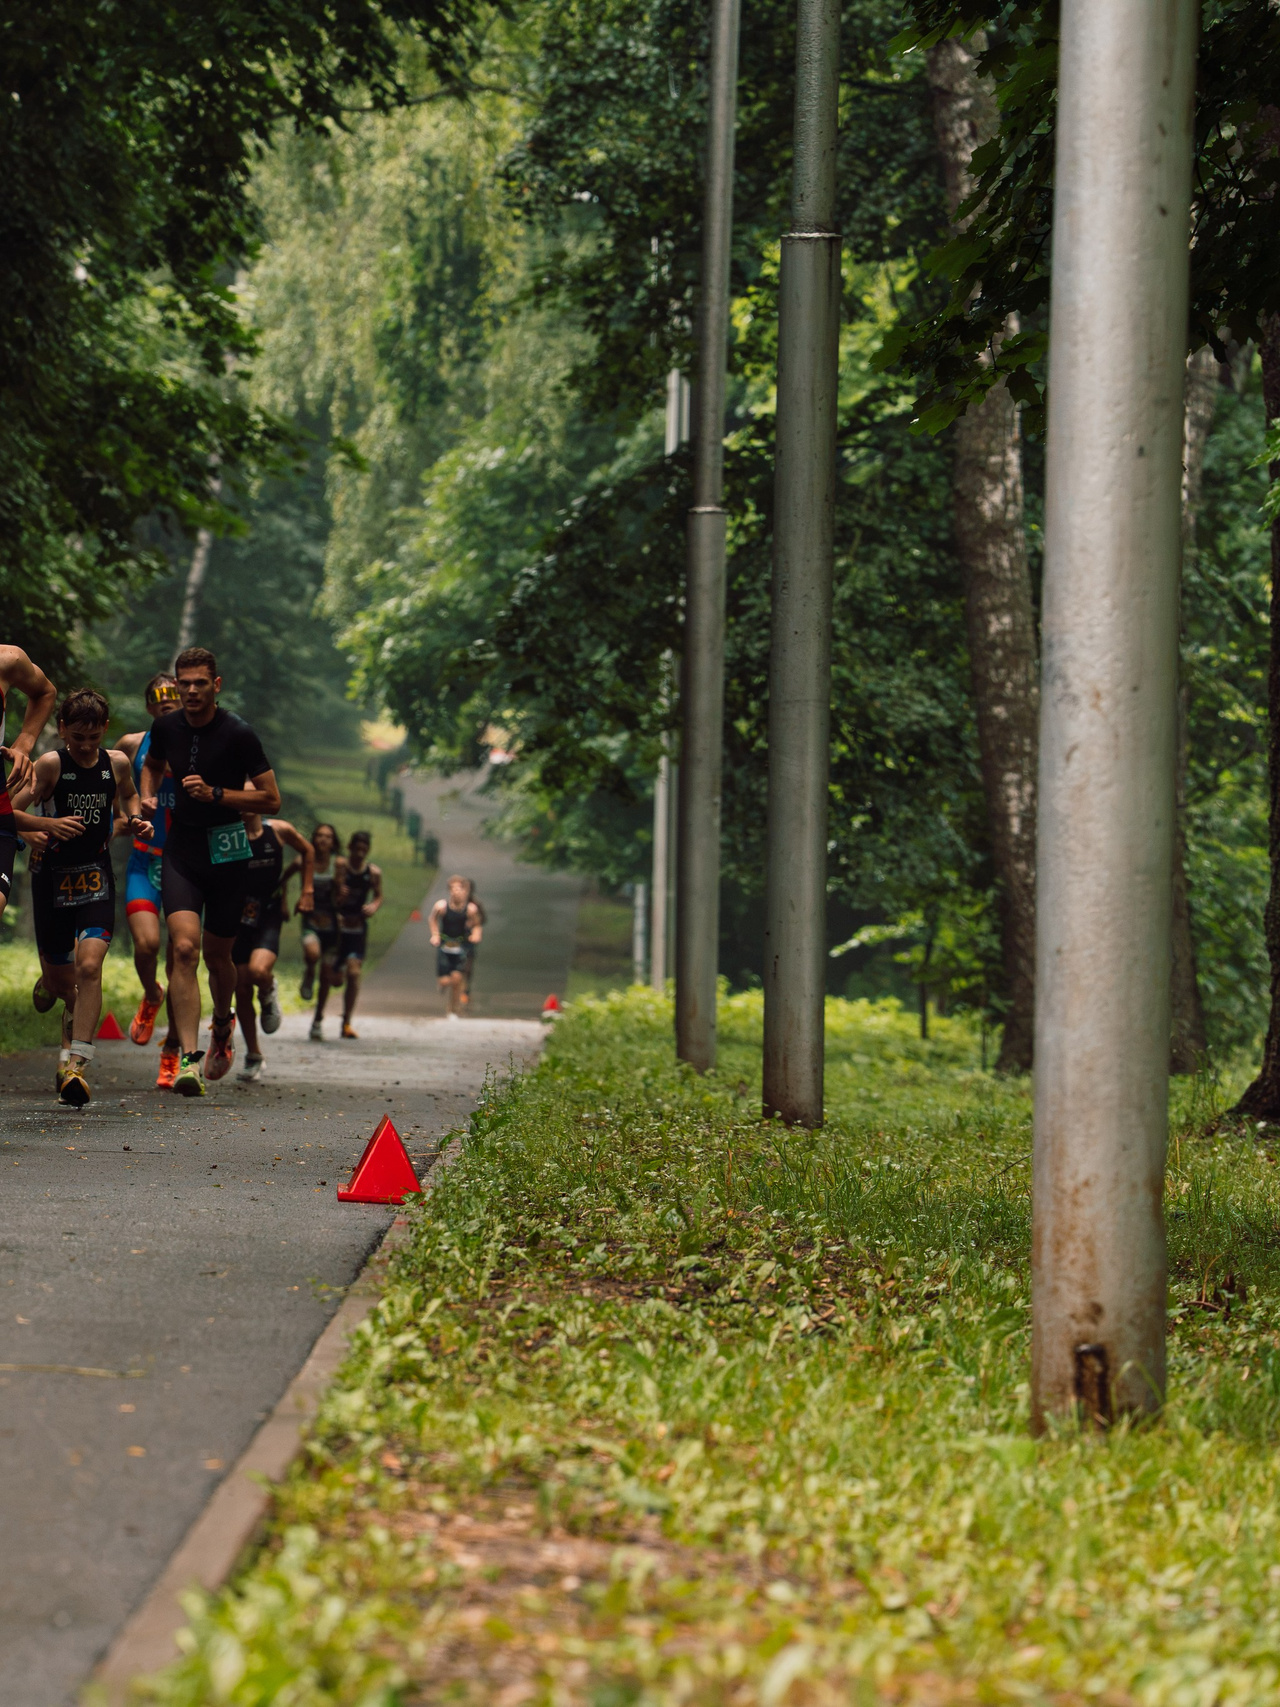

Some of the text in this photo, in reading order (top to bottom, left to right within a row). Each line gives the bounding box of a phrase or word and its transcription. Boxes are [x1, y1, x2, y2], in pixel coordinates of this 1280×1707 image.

[155, 793, 176, 807] US
[218, 829, 249, 851] 317
[59, 871, 102, 895] 443
